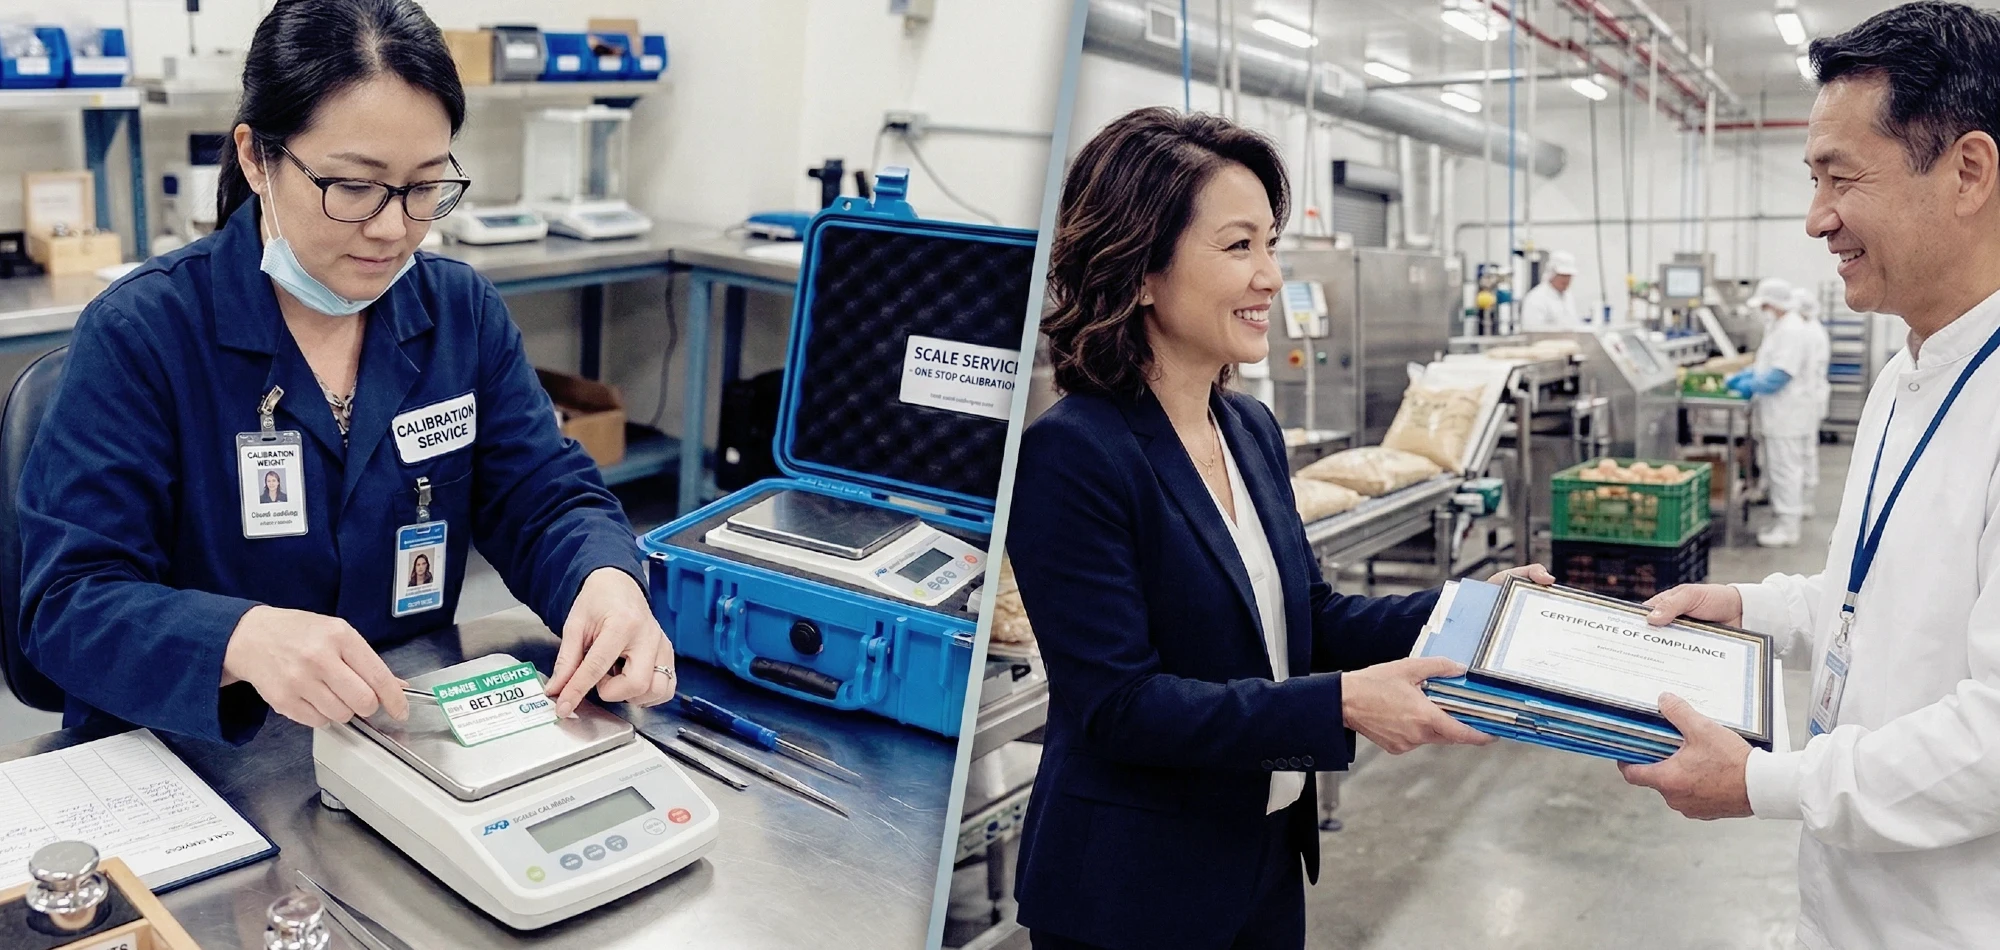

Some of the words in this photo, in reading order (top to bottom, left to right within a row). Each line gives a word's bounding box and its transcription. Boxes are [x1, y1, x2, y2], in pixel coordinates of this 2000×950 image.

[914, 346, 959, 366] SCALE
[914, 366, 932, 378] ONE
[934, 369, 957, 382] STOP
[397, 403, 474, 438] CALIBRATION
[418, 423, 468, 448] SERVICE
[247, 450, 294, 459] CALIBRATION
[1540, 610, 1619, 634] CERTIFICATE
[1622, 629, 1640, 638] OF
[1643, 634, 1726, 659] COMPLIANCE
[469, 694, 495, 711] BET
